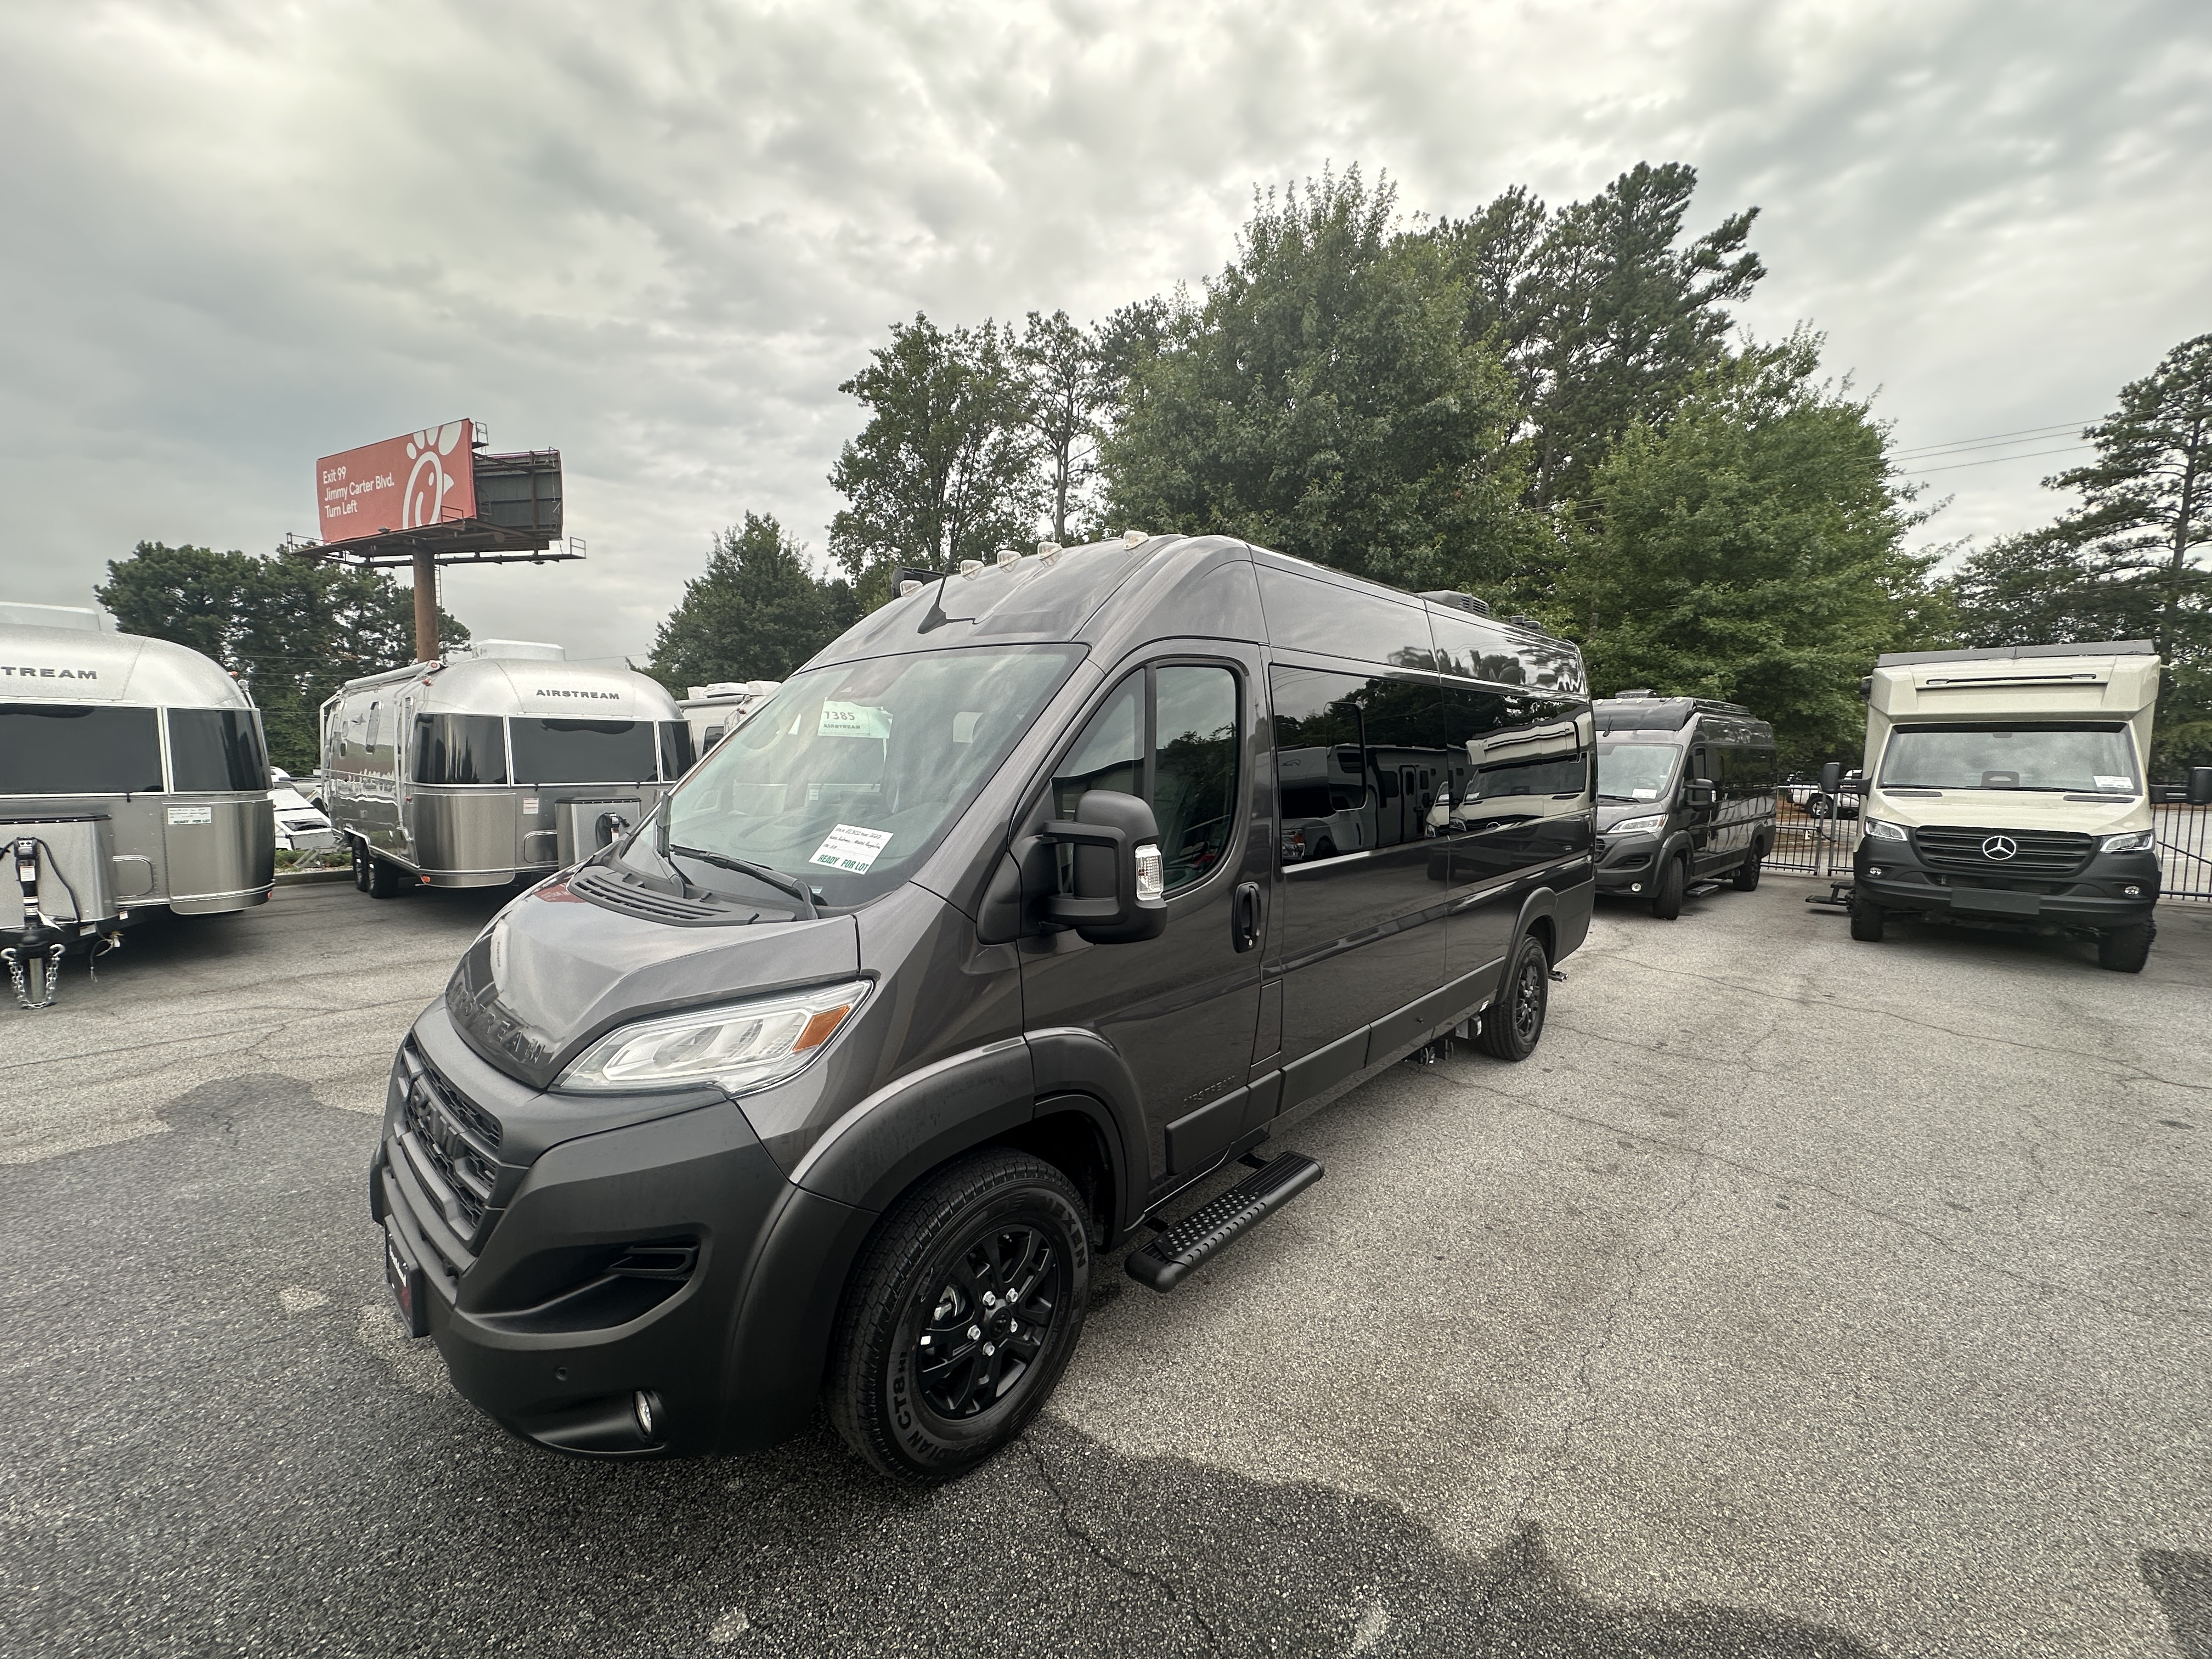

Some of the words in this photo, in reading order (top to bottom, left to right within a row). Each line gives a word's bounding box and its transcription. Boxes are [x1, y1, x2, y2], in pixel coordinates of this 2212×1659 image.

[323, 469, 337, 484] Exit
[337, 466, 346, 481] 99
[324, 487, 348, 501] Jimmy
[349, 479, 374, 495] Carter
[375, 472, 394, 489] Blvd.
[324, 505, 341, 518] Turn
[342, 499, 358, 515] Left
[0, 666, 97, 679] TREAM
[535, 689, 619, 699] AIRSTREAM
[823, 711, 855, 720] 7385
[817, 854, 840, 865] READY
[840, 859, 856, 869] FOR
[854, 862, 870, 872] LOT
[893, 1376, 912, 1430] CT8
